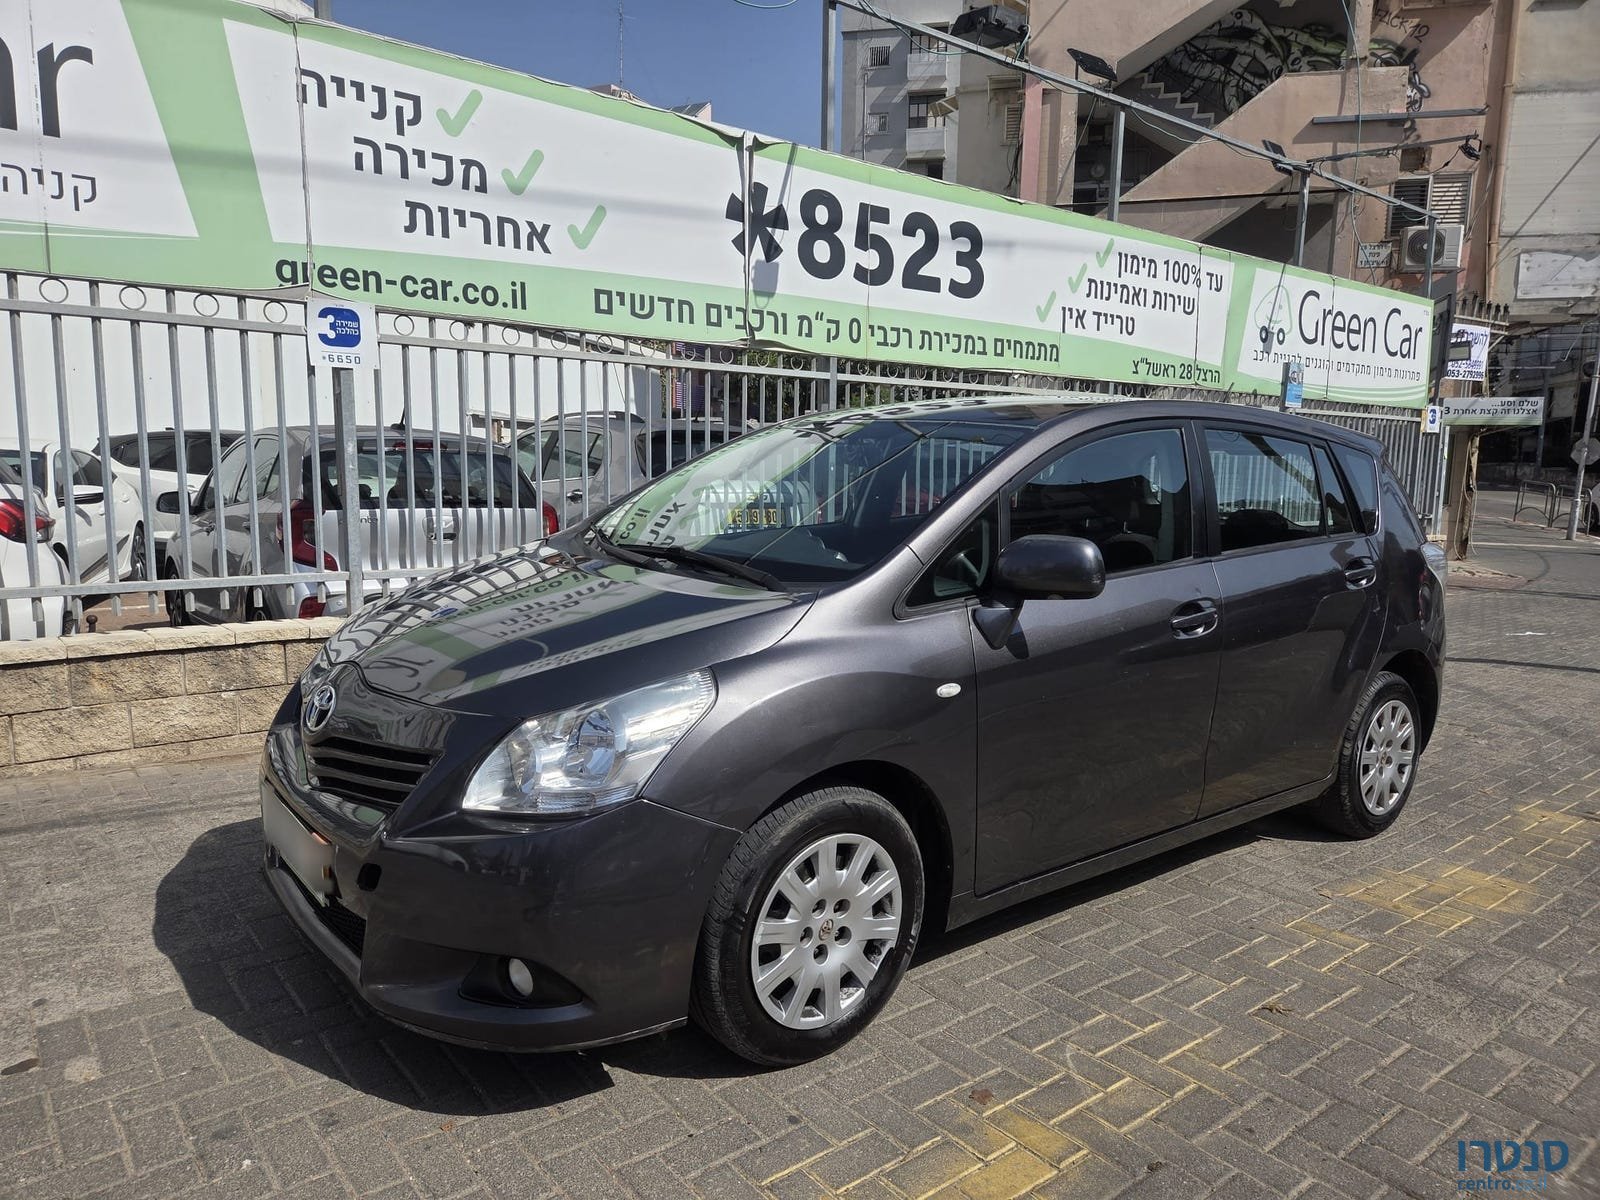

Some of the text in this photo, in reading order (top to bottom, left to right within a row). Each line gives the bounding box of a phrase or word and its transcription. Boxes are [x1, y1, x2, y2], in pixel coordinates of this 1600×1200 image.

[297, 66, 423, 138] קנייה
[352, 134, 490, 195] מכירה
[403, 198, 554, 256] אחריות
[274, 257, 528, 312] green-car.co.il
[1116, 250, 1224, 294] עד 100% מימון
[592, 286, 697, 327] חדשים
[1086, 276, 1197, 317] שירות ואמינות
[335, 319, 359, 328] שמירה
[336, 327, 360, 336] כהלכה
[706, 303, 789, 338] ורכבים
[847, 319, 863, 344] 0
[1061, 306, 1136, 337] טרייד אין
[1297, 288, 1424, 362] Green Car
[867, 323, 914, 351] רכבי
[918, 329, 988, 357] במכירת
[993, 336, 1062, 364] מתמחים
[1253, 349, 1271, 363] רכב
[1336, 360, 1372, 376] מתקדמים
[1179, 362, 1193, 382] 28
[1195, 364, 1221, 385] הרצל
[1373, 365, 1393, 380] מימון
[1394, 367, 1421, 382] פתרונות
[1443, 406, 1538, 417] אצלנו זה קצת אחרת 3
[1518, 399, 1539, 407] שלם
